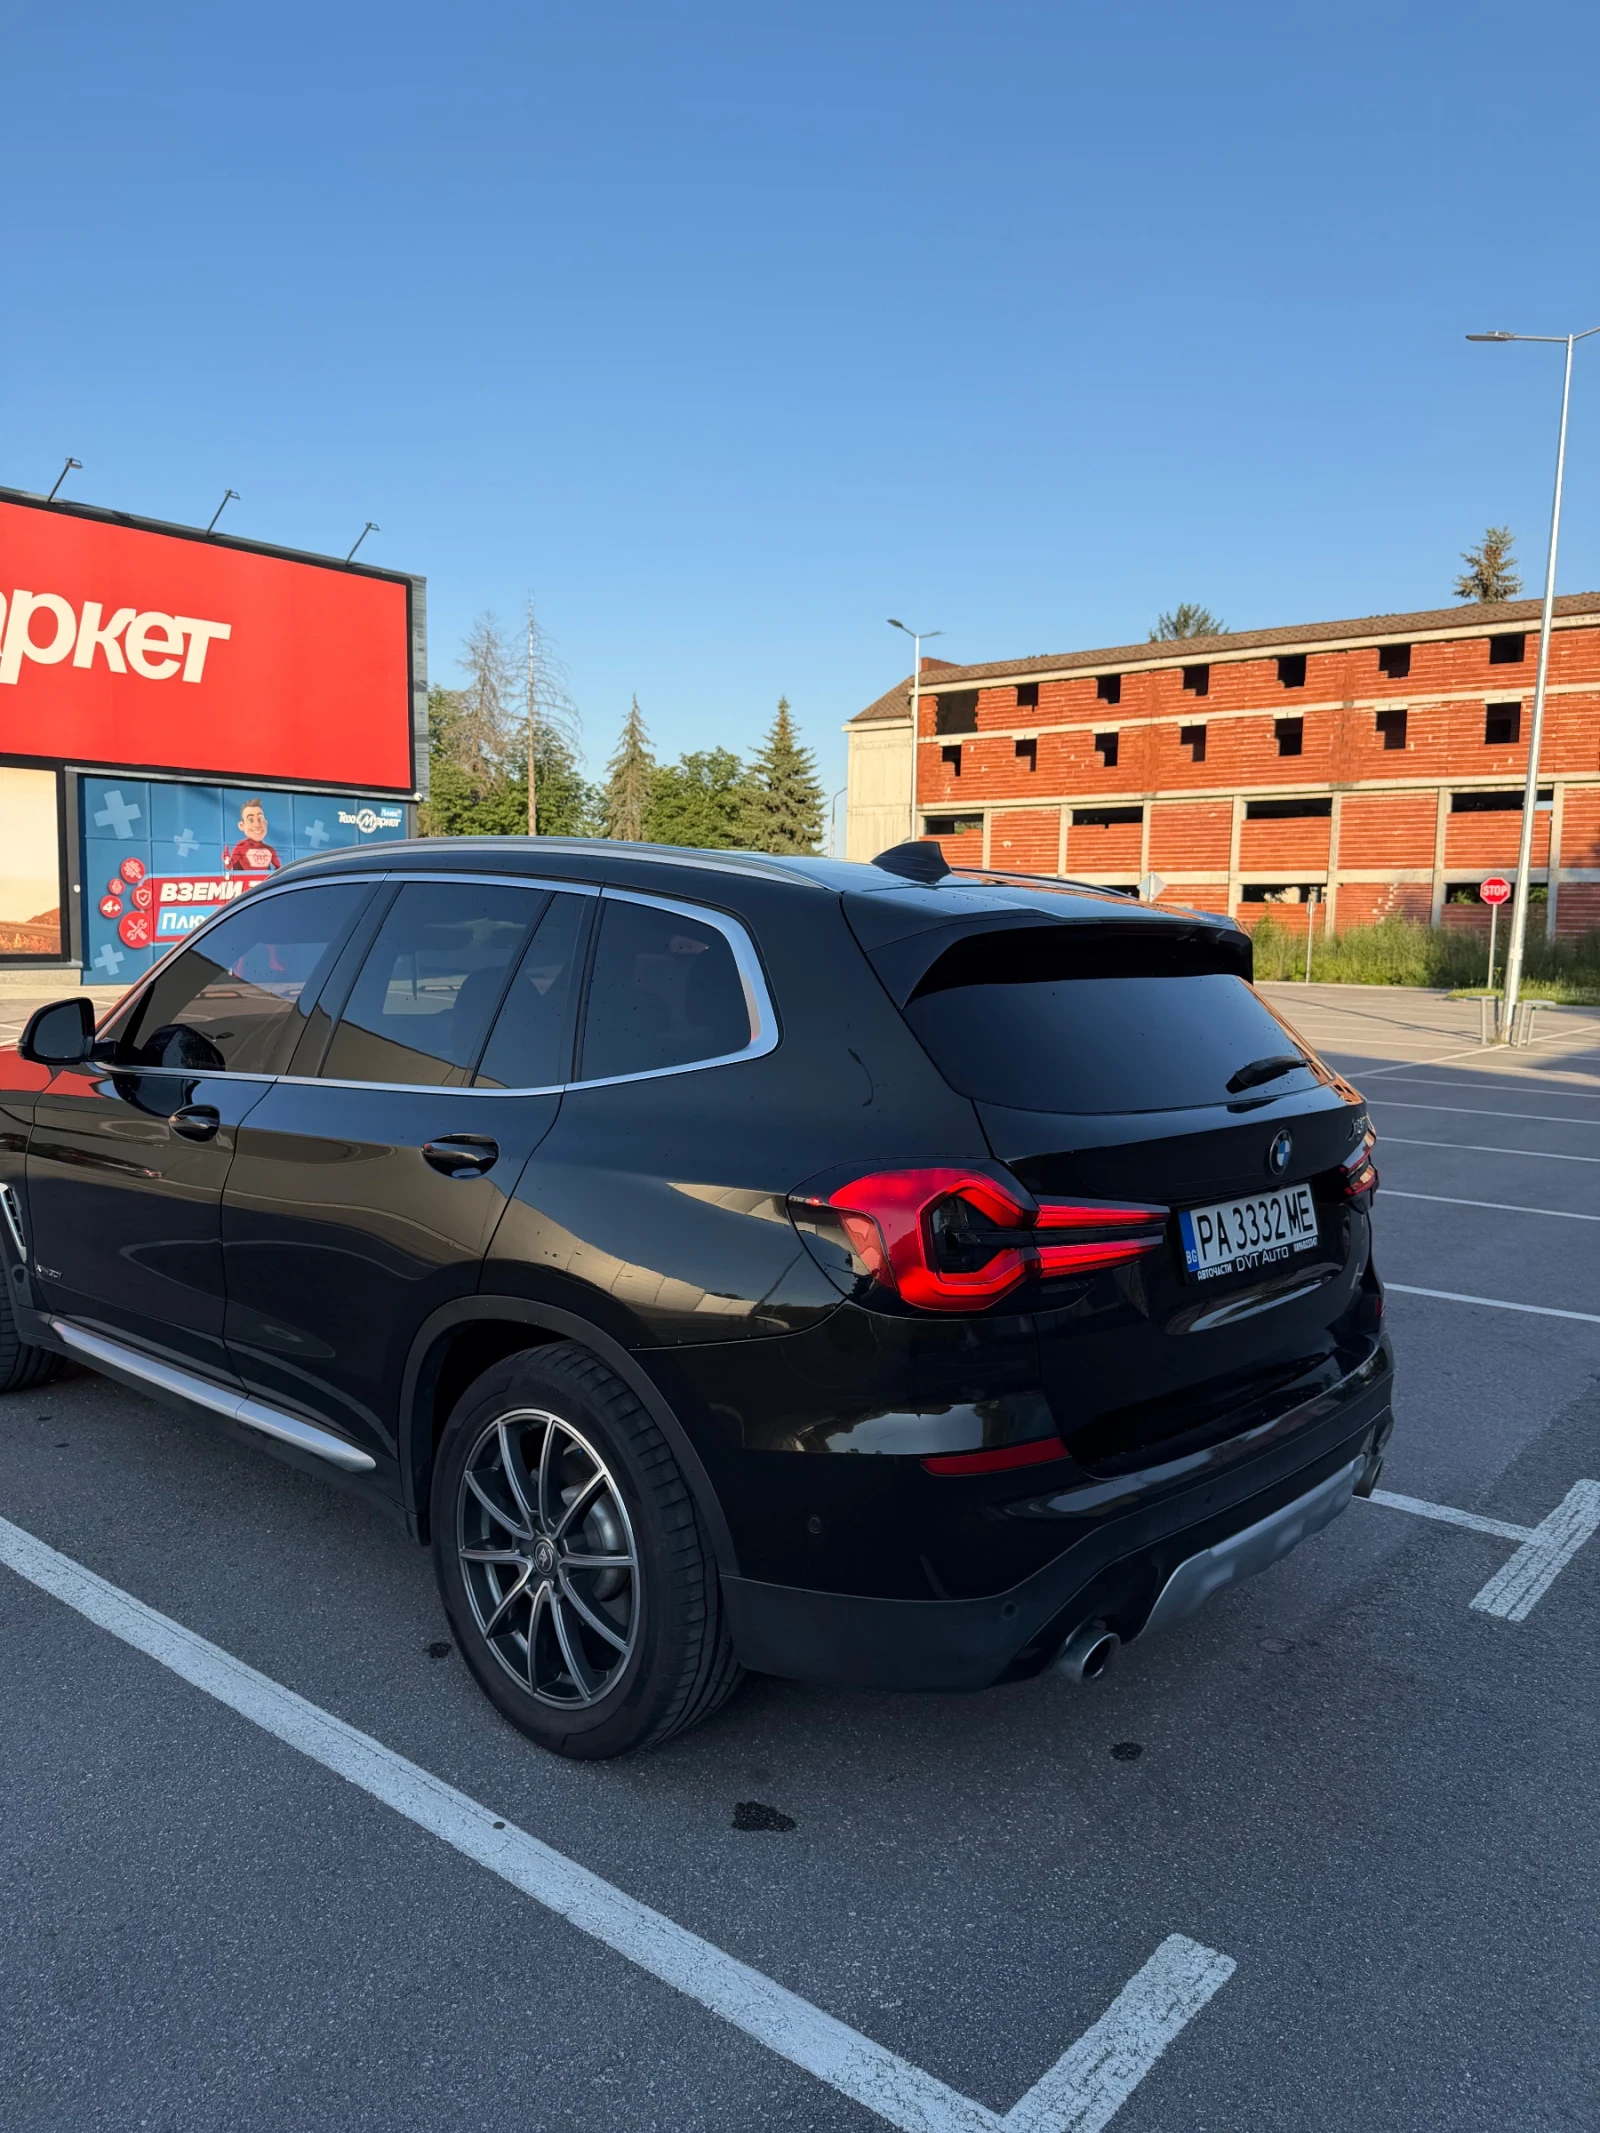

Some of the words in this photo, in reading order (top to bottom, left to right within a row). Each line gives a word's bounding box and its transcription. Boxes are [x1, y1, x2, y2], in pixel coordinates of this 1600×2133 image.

[0, 588, 232, 686] ркет
[160, 881, 243, 902] ВЗЕМИ
[1482, 885, 1508, 897] STOP
[1186, 1249, 1198, 1265] BG
[1236, 1252, 1260, 1272] DVT
